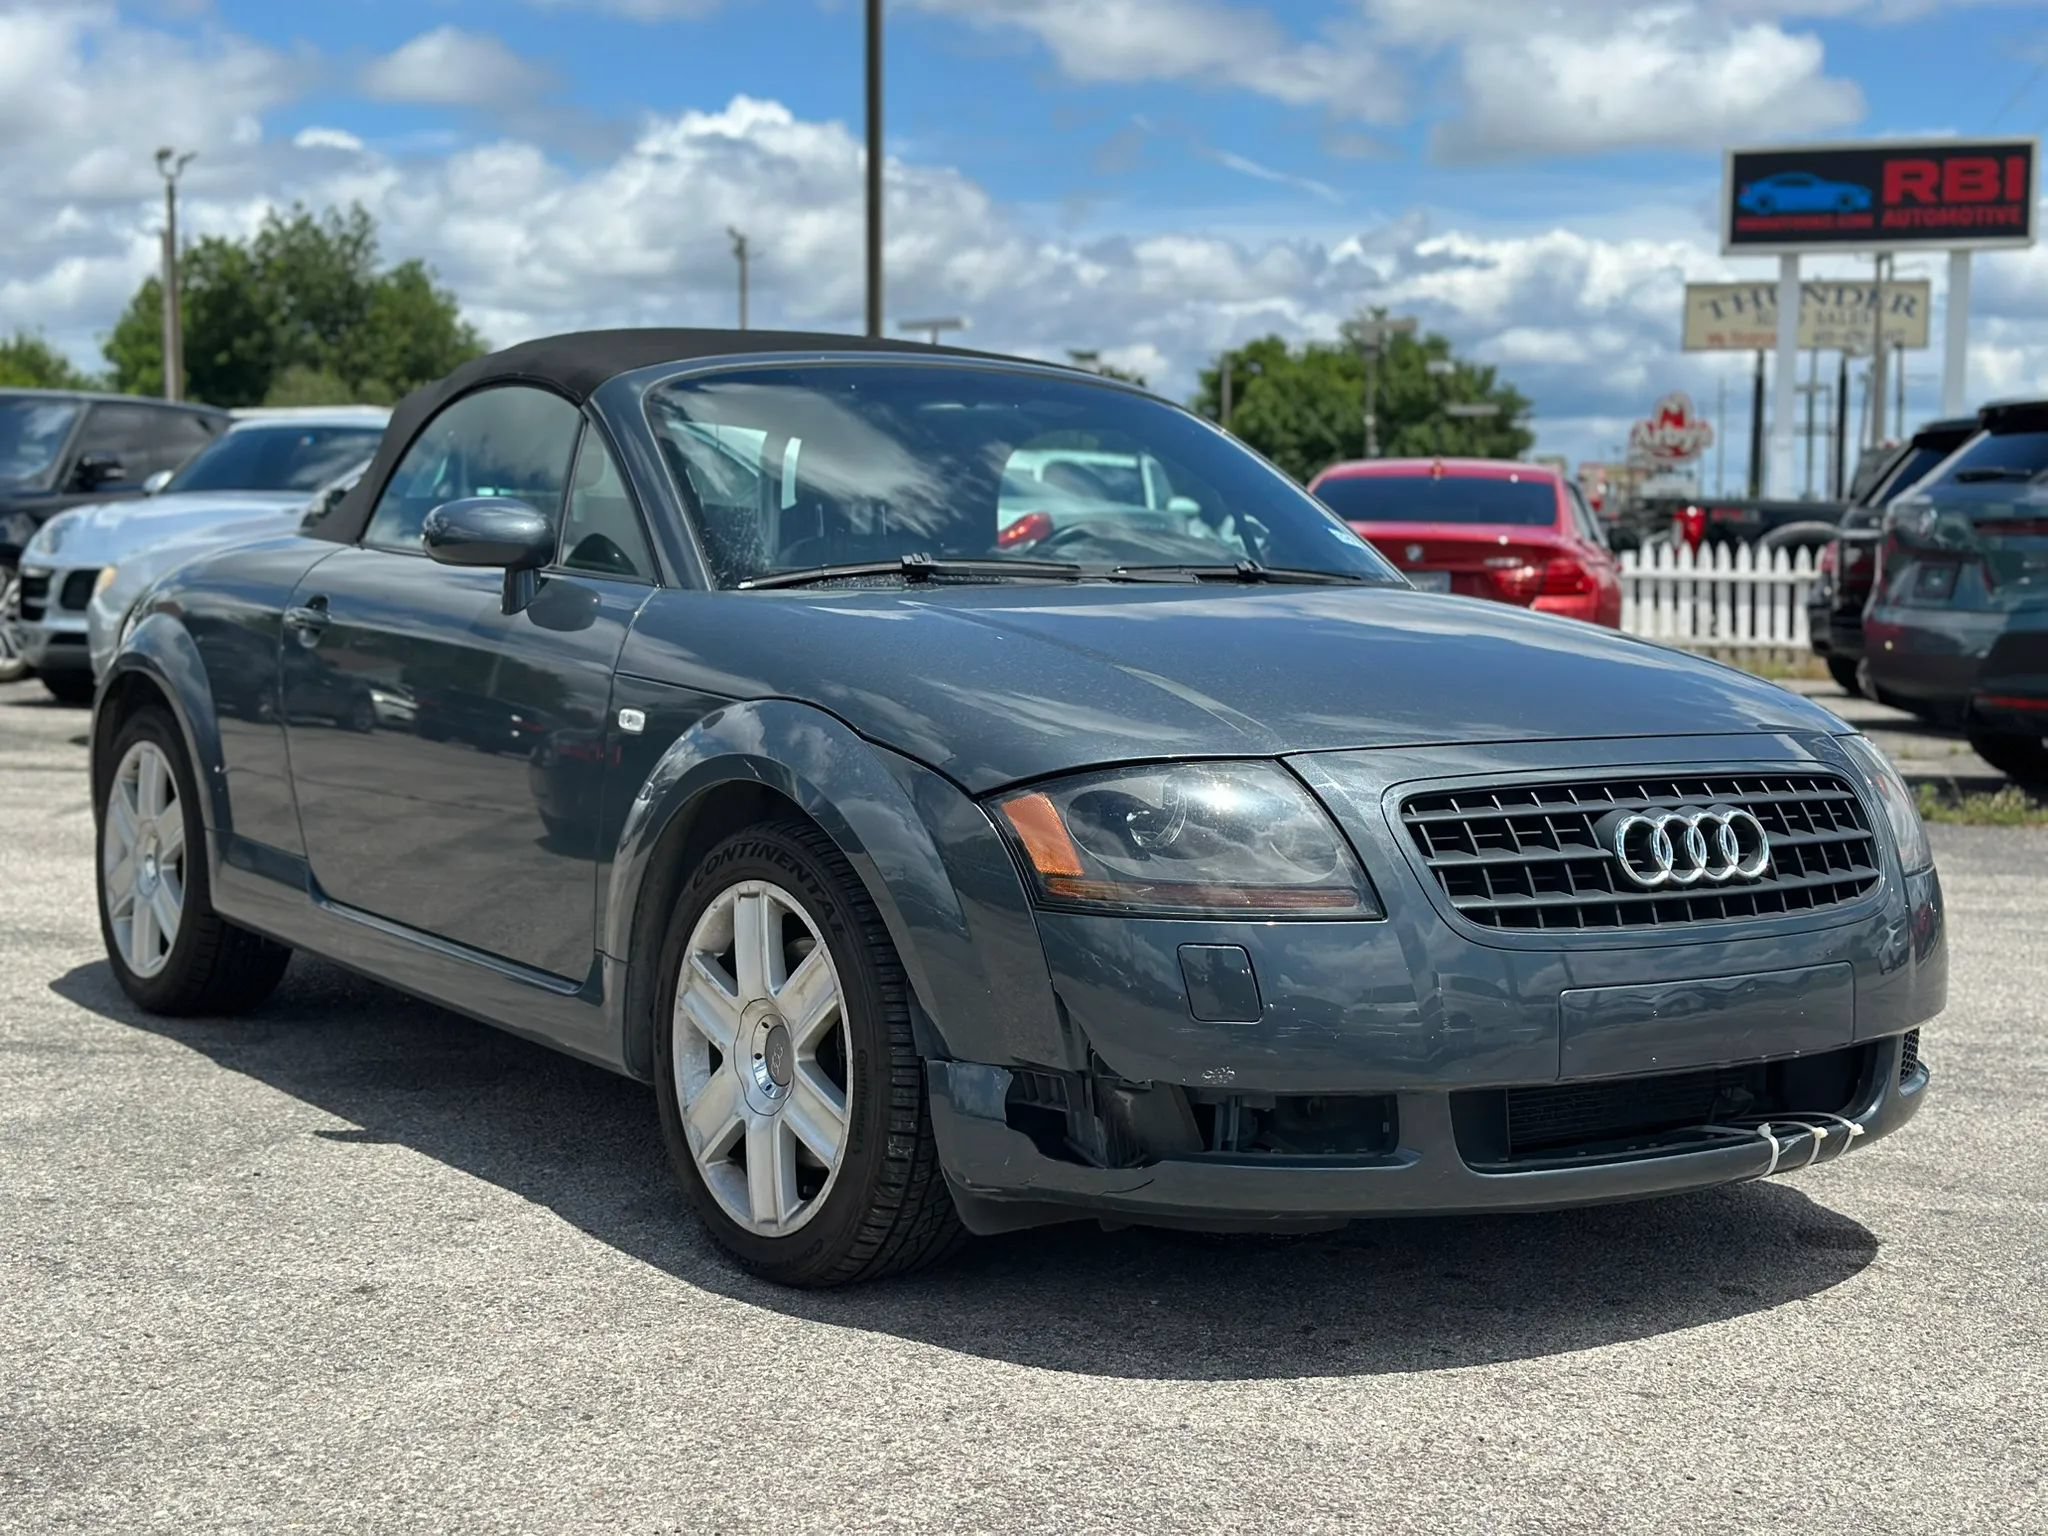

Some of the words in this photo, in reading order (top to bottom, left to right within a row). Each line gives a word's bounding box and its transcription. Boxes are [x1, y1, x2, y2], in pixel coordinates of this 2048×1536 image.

[1882, 155, 2027, 206] RBI
[1881, 205, 2023, 229] AUTOMOTIVE
[1699, 286, 1917, 321] THNDER
[692, 841, 846, 943] CONTINENTAL
